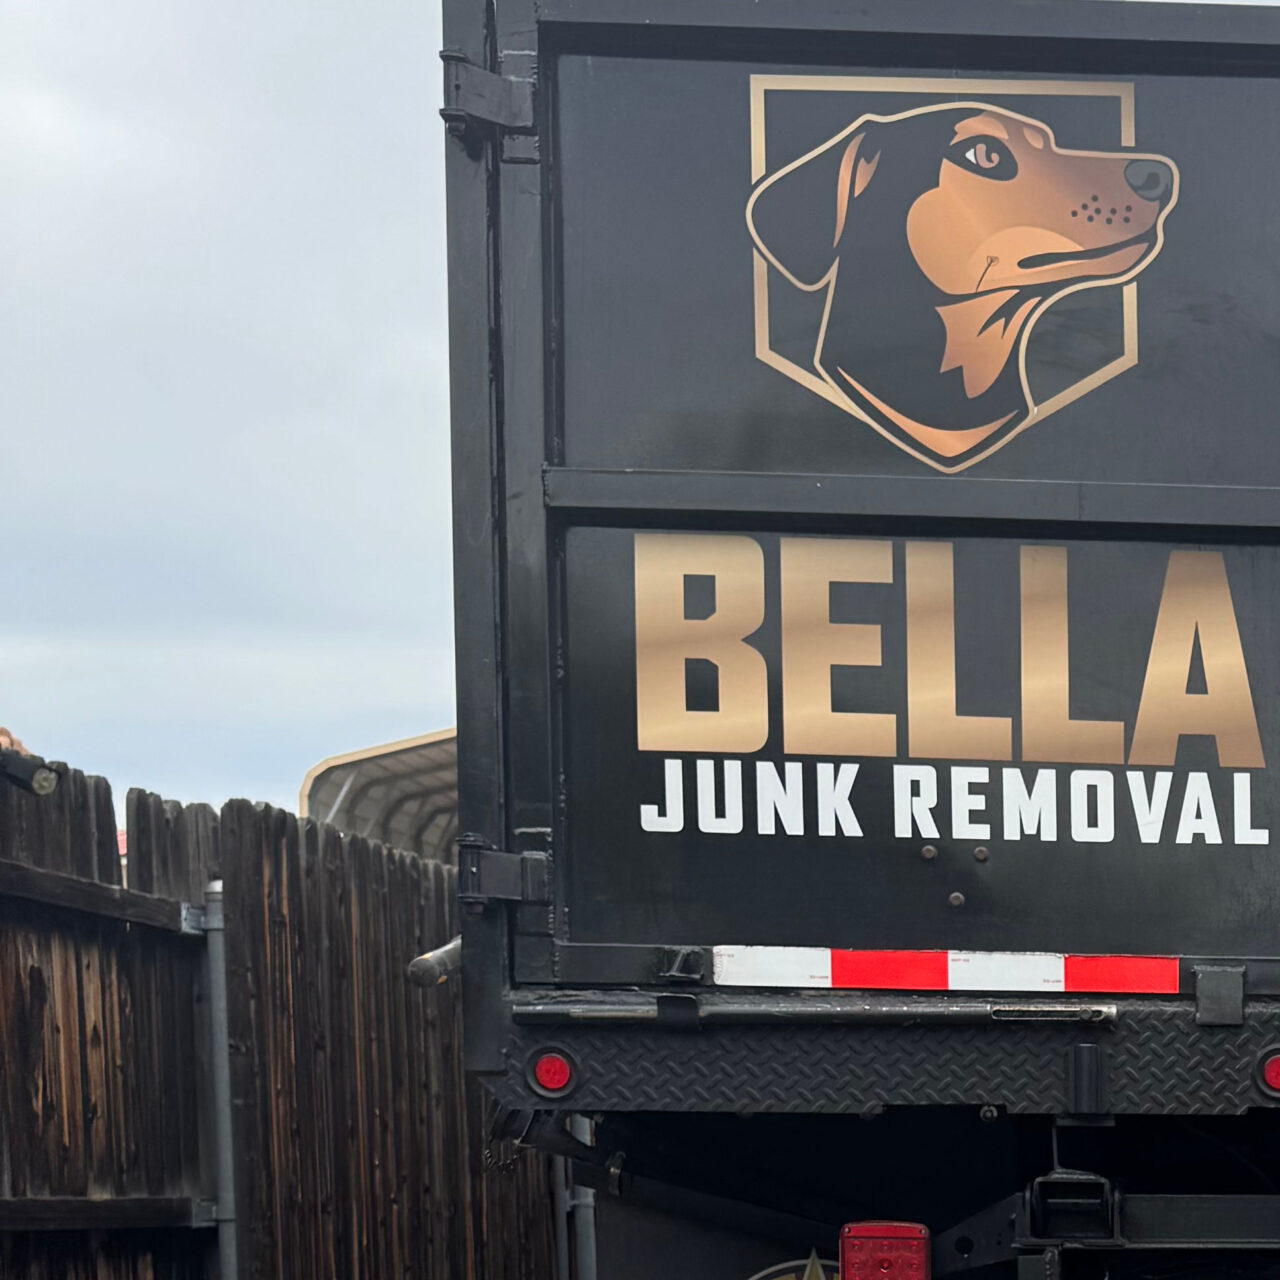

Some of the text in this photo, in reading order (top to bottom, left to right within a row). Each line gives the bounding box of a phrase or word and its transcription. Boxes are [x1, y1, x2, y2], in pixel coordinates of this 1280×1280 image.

[634, 533, 1265, 768] BELLA
[640, 759, 1270, 846] JUNK REMOVAL
